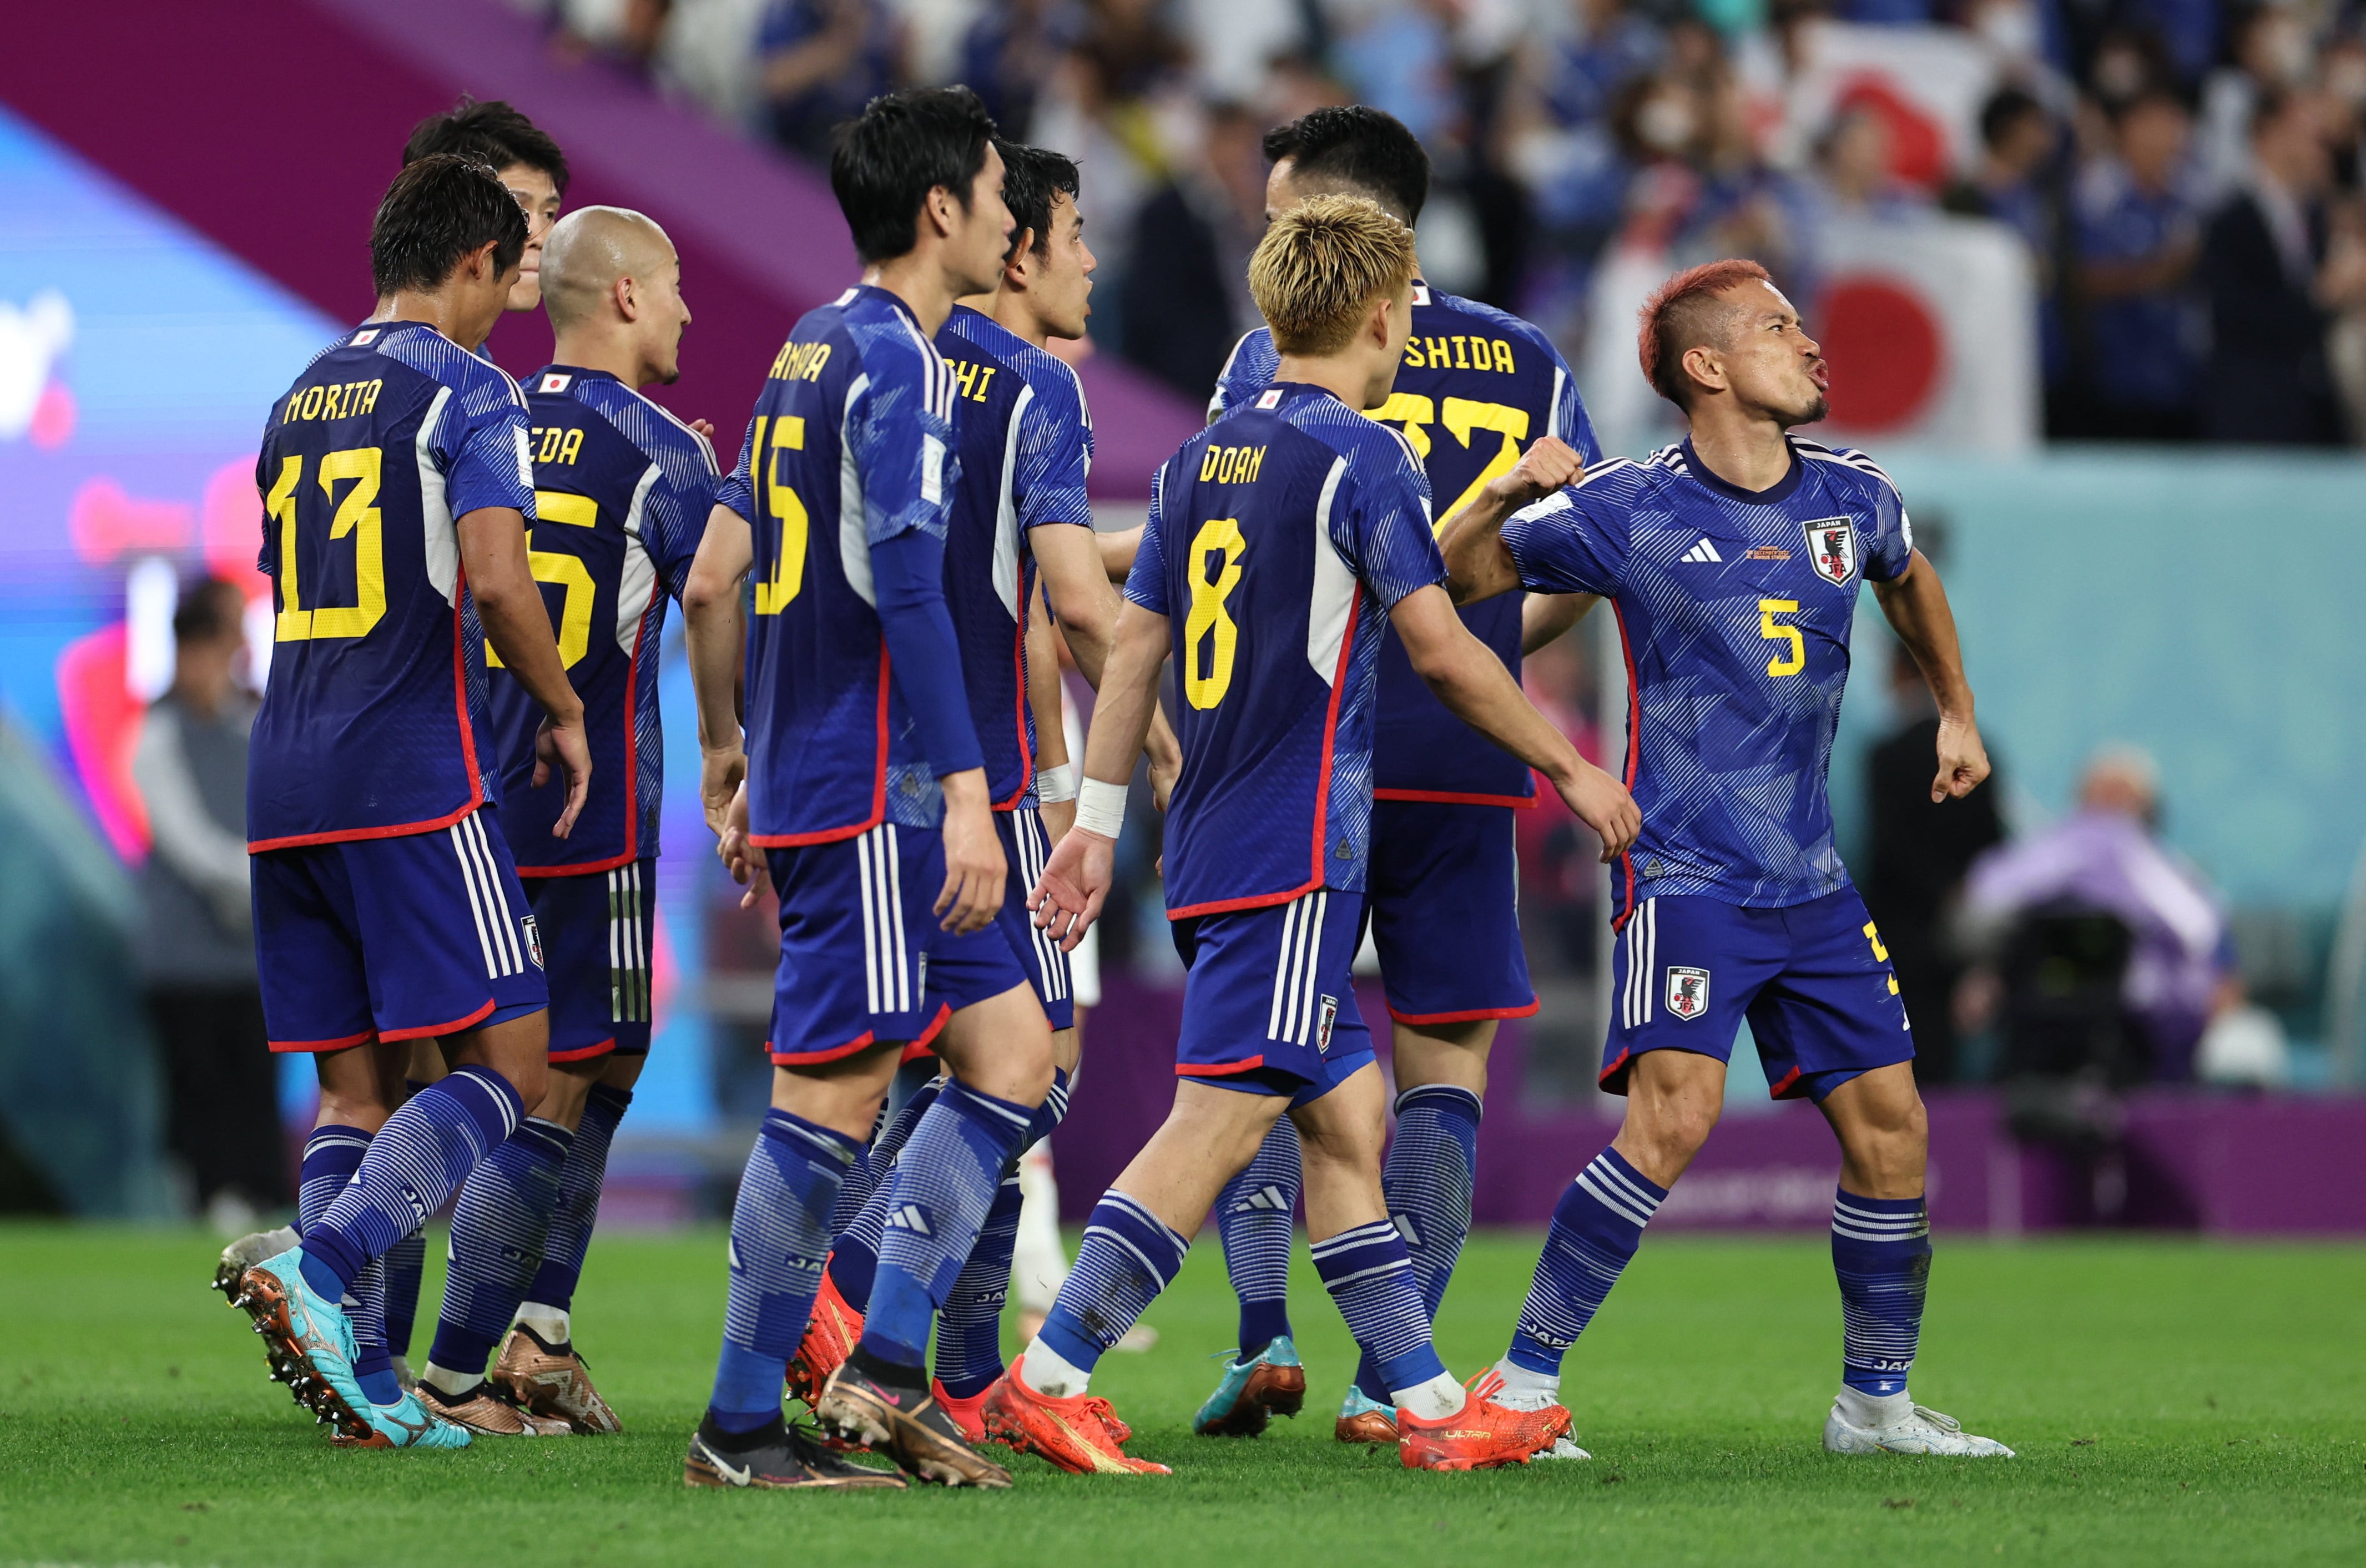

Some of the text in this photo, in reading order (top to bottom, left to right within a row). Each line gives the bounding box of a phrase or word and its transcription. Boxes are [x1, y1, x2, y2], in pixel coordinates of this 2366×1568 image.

[283, 379, 383, 425] MORITA
[1199, 445, 1267, 484] DOAN
[267, 447, 386, 642] 13
[1185, 518, 1246, 710] 8
[1758, 599, 1805, 677] 5
[1677, 1002, 1696, 1011] JFA
[1445, 1430, 1492, 1441] ULTRA
